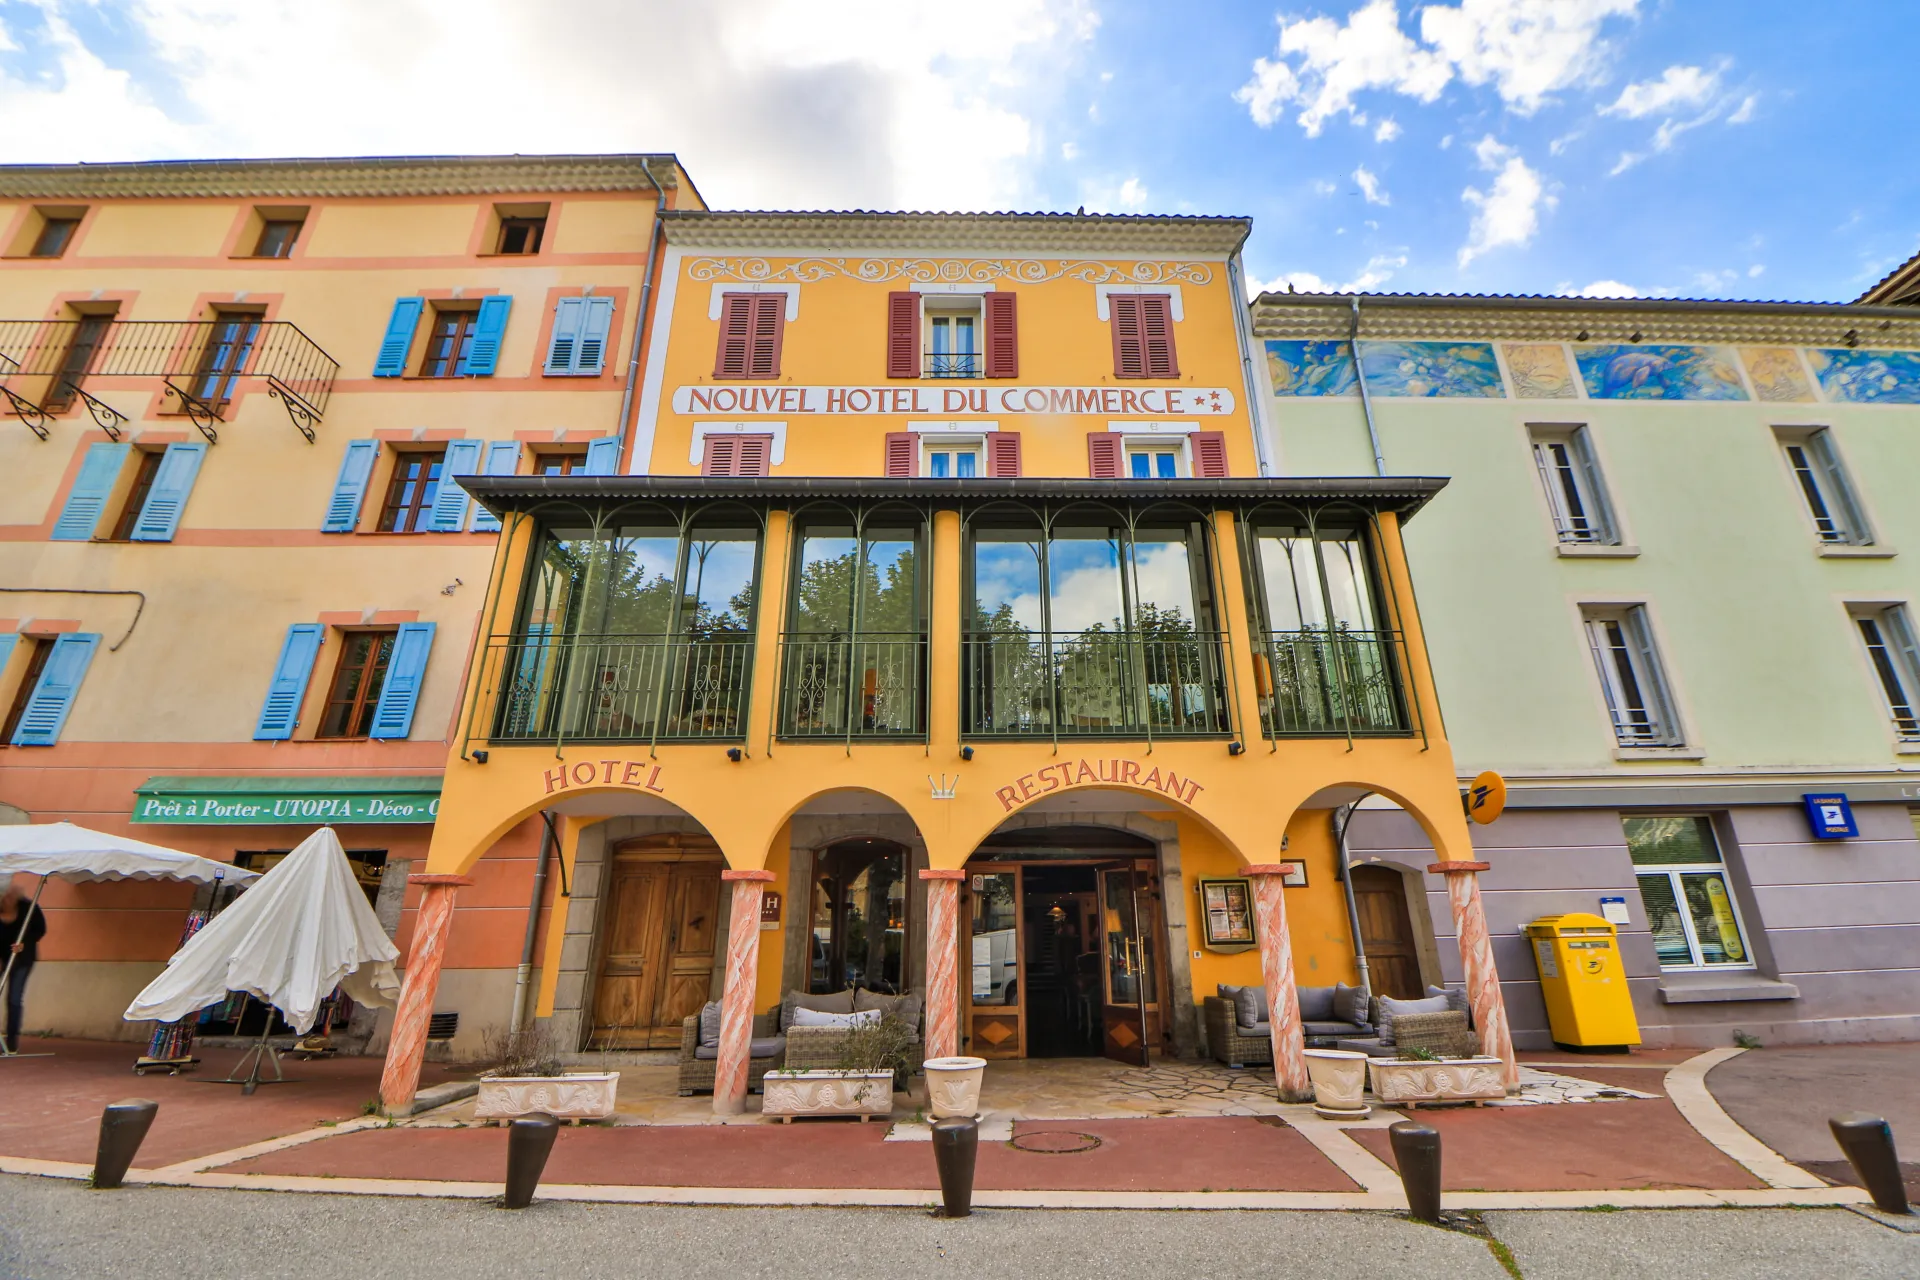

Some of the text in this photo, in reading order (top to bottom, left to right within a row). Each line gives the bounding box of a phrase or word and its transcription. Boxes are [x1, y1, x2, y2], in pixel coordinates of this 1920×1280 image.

[688, 388, 1185, 413] NOUVEL HOTEL DU COMMERCE
[543, 760, 664, 794] HOTEL
[994, 758, 1204, 812] RESTAURANT
[142, 799, 182, 817] Prêt
[184, 800, 197, 816] à
[201, 799, 260, 817] Porter
[273, 799, 351, 817] UTOPIA
[367, 799, 413, 816] Déco
[767, 897, 778, 909] H
